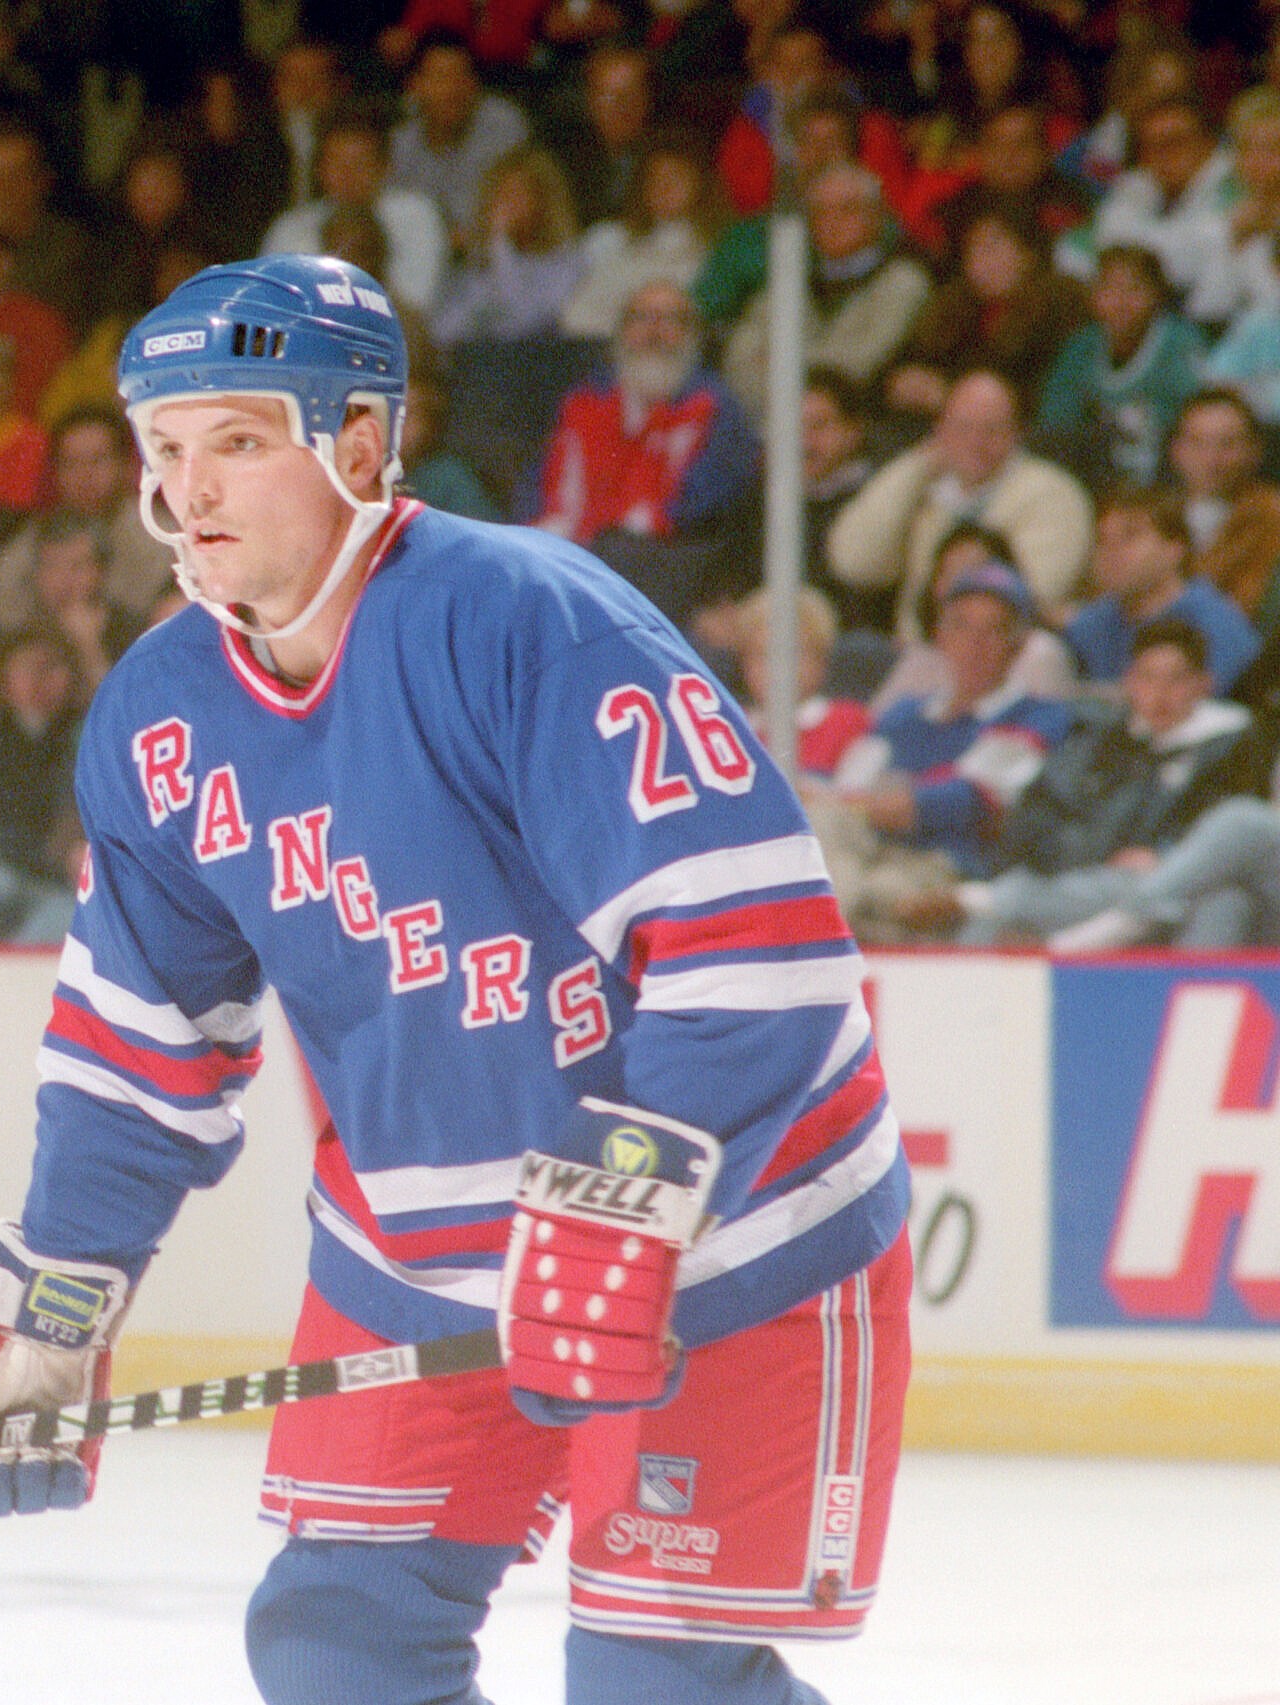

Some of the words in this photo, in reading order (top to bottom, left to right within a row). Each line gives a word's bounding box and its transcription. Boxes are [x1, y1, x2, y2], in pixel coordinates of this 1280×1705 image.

[147, 333, 204, 355] CCM
[596, 672, 756, 824] 26
[133, 717, 611, 1069] RANGERS
[605, 1512, 719, 1562] Supra
